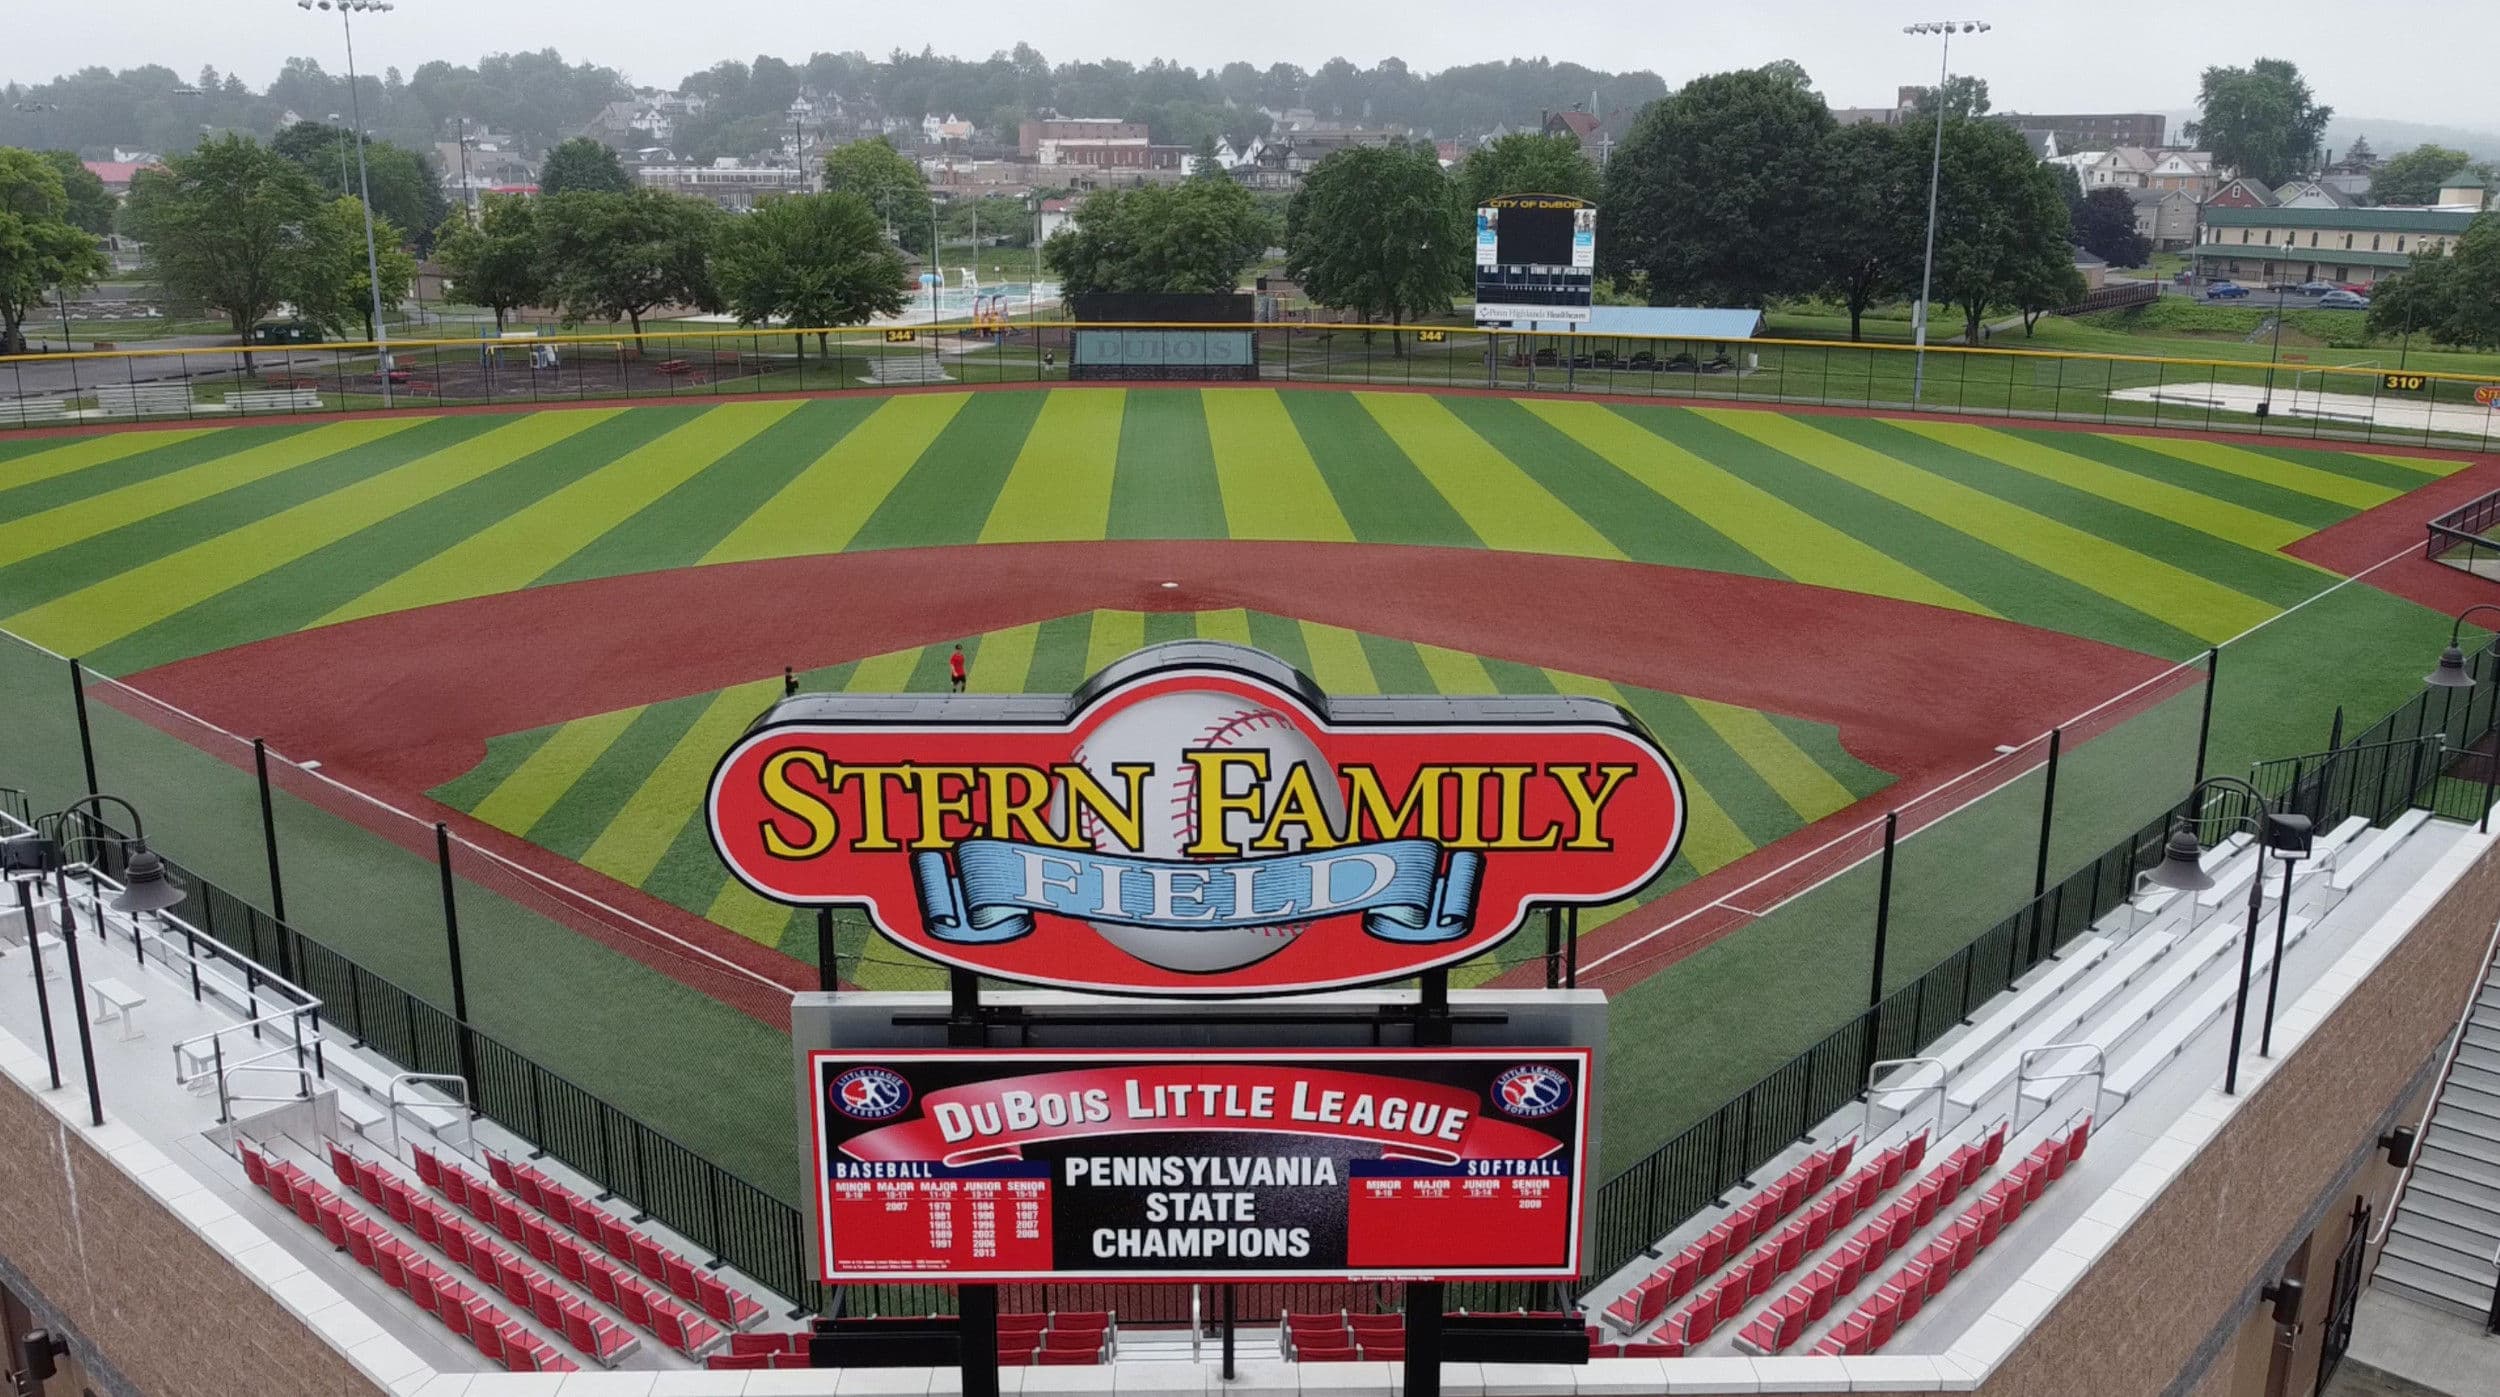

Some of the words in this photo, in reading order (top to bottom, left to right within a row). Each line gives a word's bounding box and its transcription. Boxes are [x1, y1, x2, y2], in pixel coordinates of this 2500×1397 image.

[1490, 200, 1518, 208] CITY
[1520, 200, 1536, 208] OF
[888, 330, 914, 342] 344'
[1419, 330, 1444, 342] 344'
[2386, 375, 2422, 390] 310'
[759, 747, 1155, 860] STERN
[1181, 746, 1638, 858] FAMILY
[1011, 842, 1398, 922] FIELD
[837, 1069, 867, 1087] LITTLE
[867, 1069, 904, 1087] LEAGUE
[1497, 1066, 1528, 1085] LITTLE
[1530, 1066, 1567, 1085] LEAGUE
[845, 1104, 902, 1118] BASEBALL
[1124, 1079, 1276, 1122] LITTLE
[1290, 1080, 1471, 1142] LEAGUE
[1504, 1103, 1559, 1116] SOFTBALL
[836, 1162, 933, 1178] BASEBALL
[1065, 1156, 1338, 1187] PENNSYLVANIA
[1467, 1160, 1561, 1176] SOFTBALL
[835, 1181, 871, 1192] MINOR
[877, 1181, 914, 1192] MAJOR
[920, 1181, 958, 1192] MAJOR
[963, 1181, 1002, 1192] JUNIOR
[1007, 1181, 1045, 1192] SENIOR
[1366, 1180, 1402, 1190] MINOR
[1413, 1180, 1450, 1190] MAJOR
[1462, 1179, 1500, 1190] JUNIOR
[1512, 1179, 1550, 1190] SENIOR
[1145, 1192, 1256, 1223] STATE
[1092, 1228, 1311, 1259] CHAMPIONS
